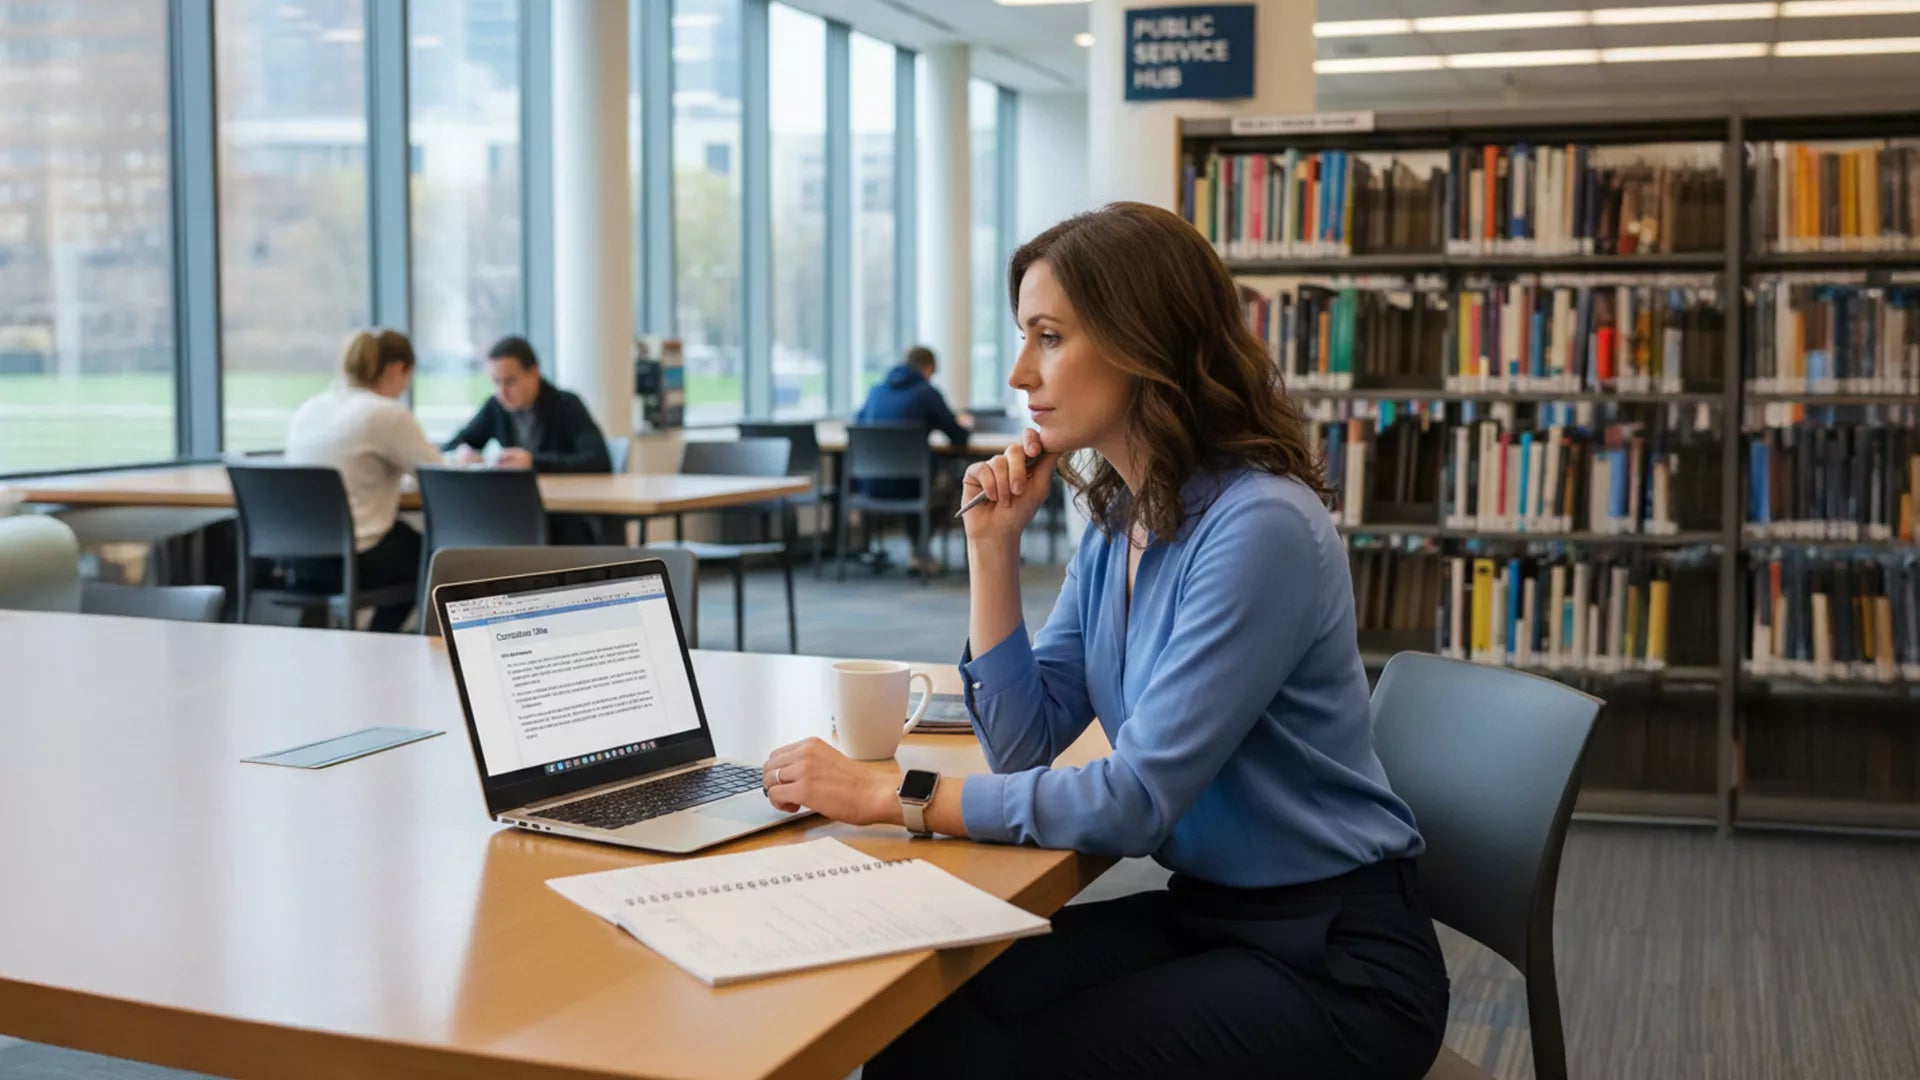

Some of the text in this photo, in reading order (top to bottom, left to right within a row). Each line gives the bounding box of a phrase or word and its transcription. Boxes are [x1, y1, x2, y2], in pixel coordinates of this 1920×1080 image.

[1133, 15, 1214, 38] PUBLIC
[1133, 40, 1229, 64] SERVICE
[1133, 67, 1182, 89] HUB
